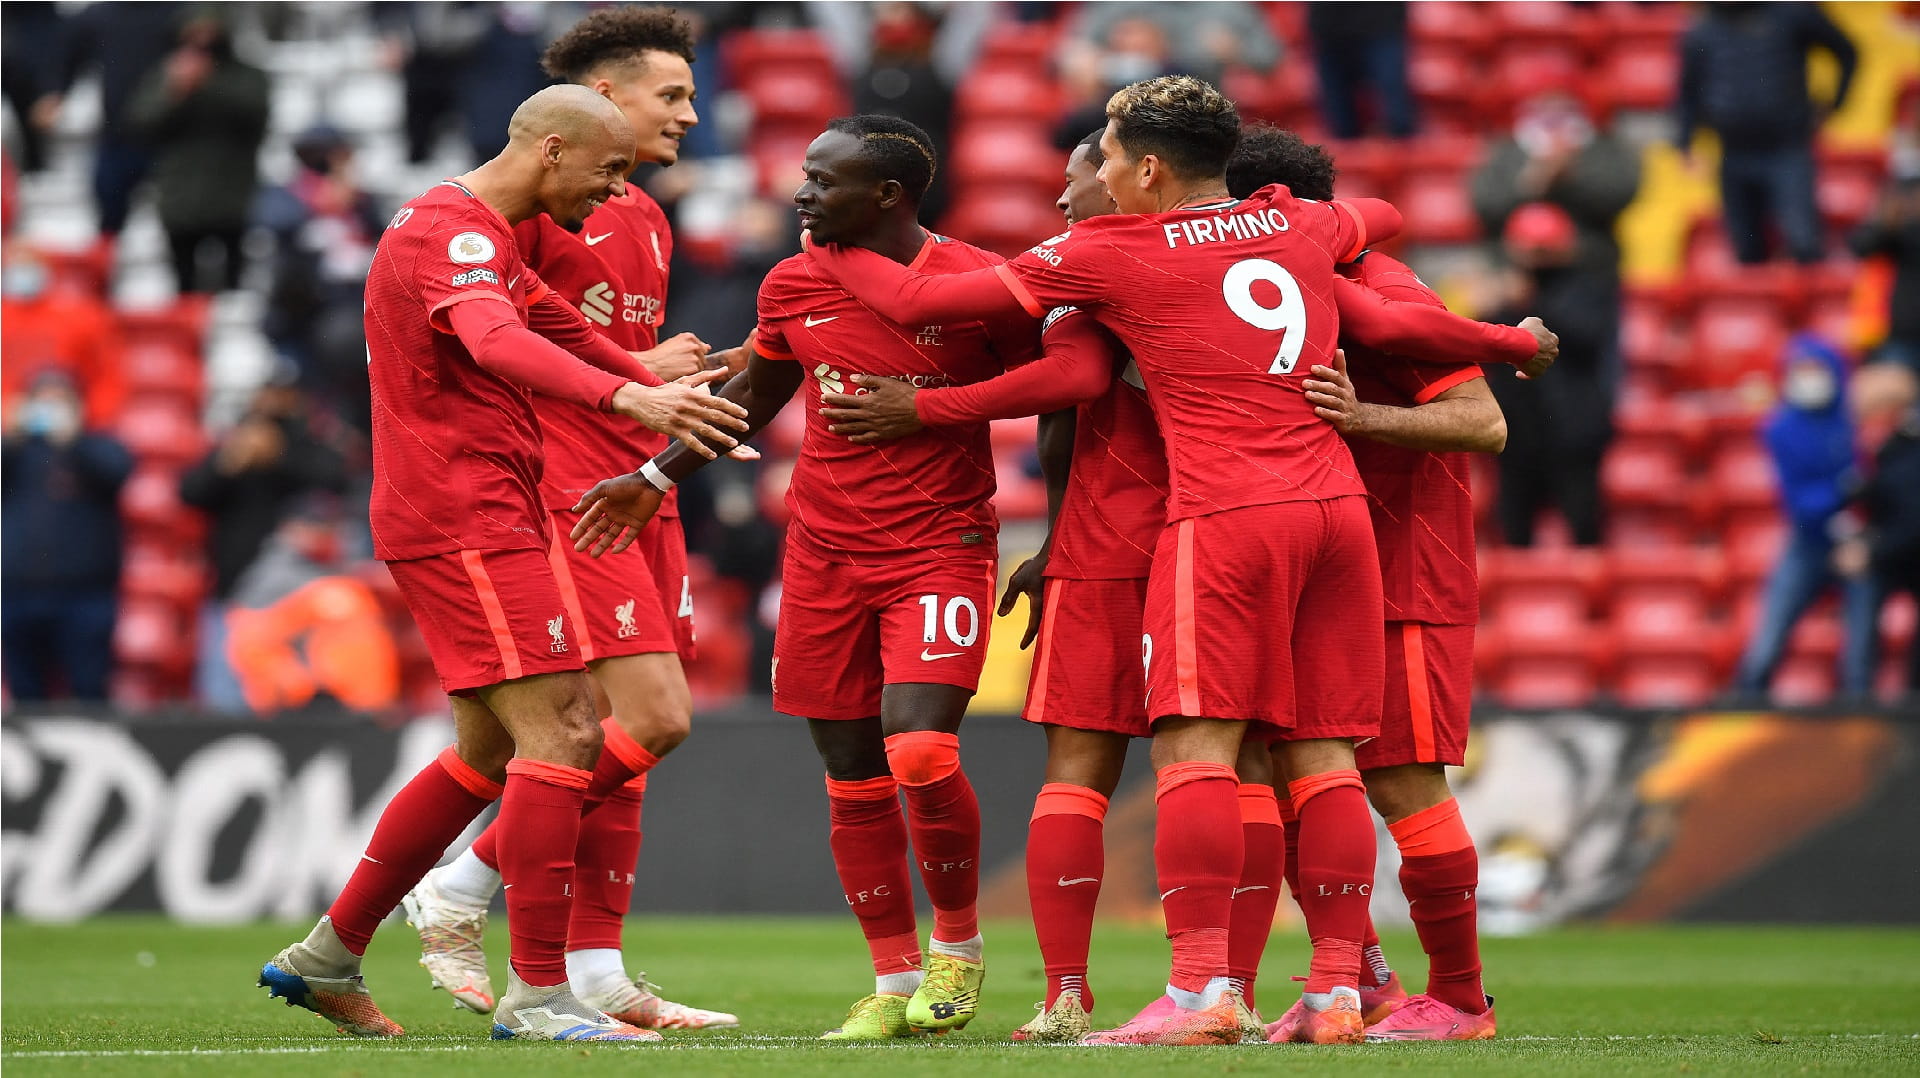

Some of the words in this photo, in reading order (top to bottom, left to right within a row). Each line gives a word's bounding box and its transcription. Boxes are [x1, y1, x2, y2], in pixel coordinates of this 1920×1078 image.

[1163, 208, 1290, 248] FIRMINO
[1024, 245, 1063, 267] edia
[1222, 258, 1307, 374] 9
[918, 594, 979, 647] 10
